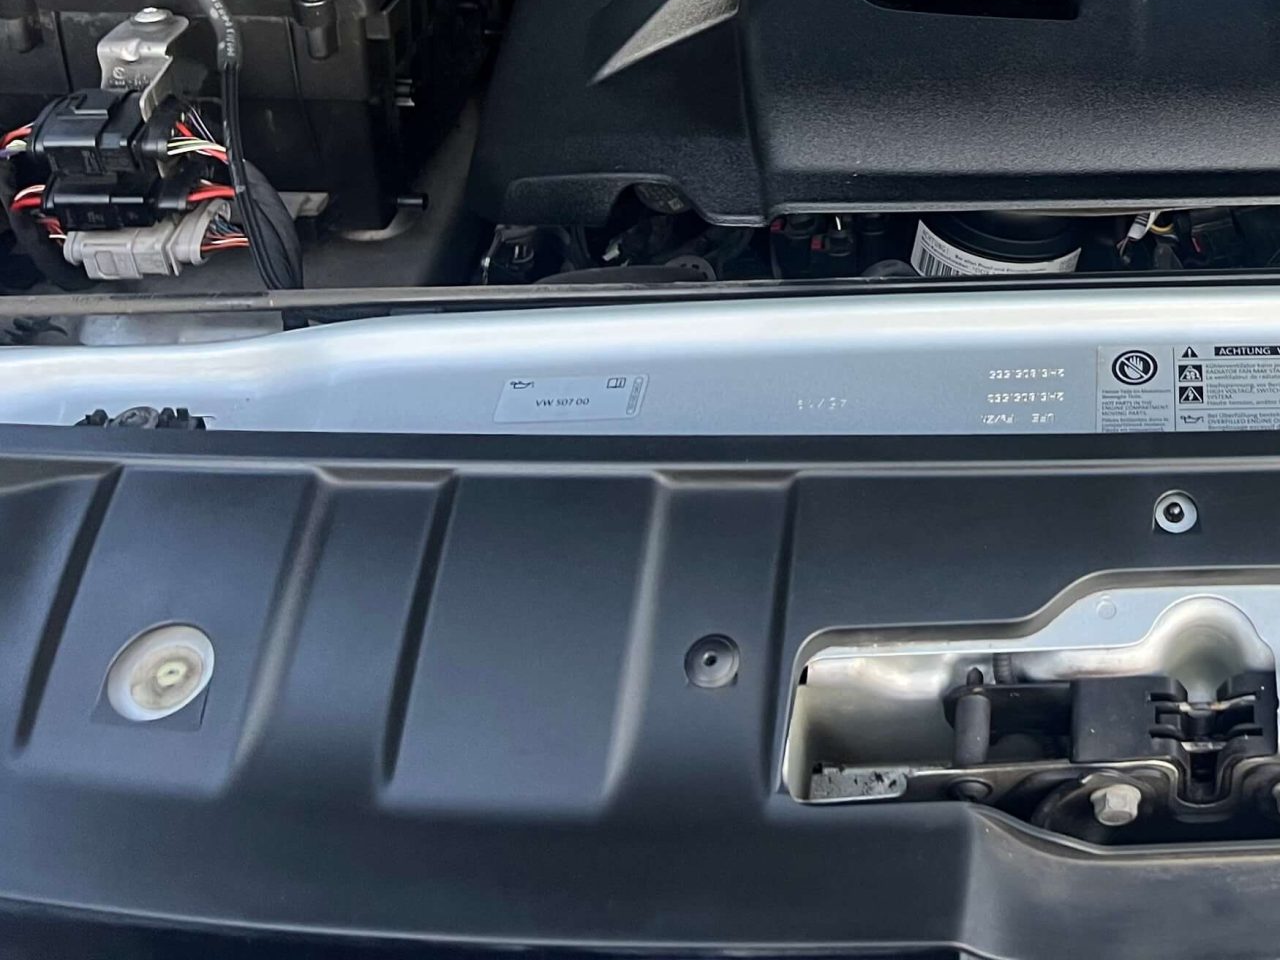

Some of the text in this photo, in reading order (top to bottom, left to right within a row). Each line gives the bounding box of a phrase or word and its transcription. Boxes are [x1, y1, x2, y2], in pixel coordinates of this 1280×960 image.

[1218, 346, 1271, 356] ACHTUNG
[535, 398, 590, 407] VW 507 00
